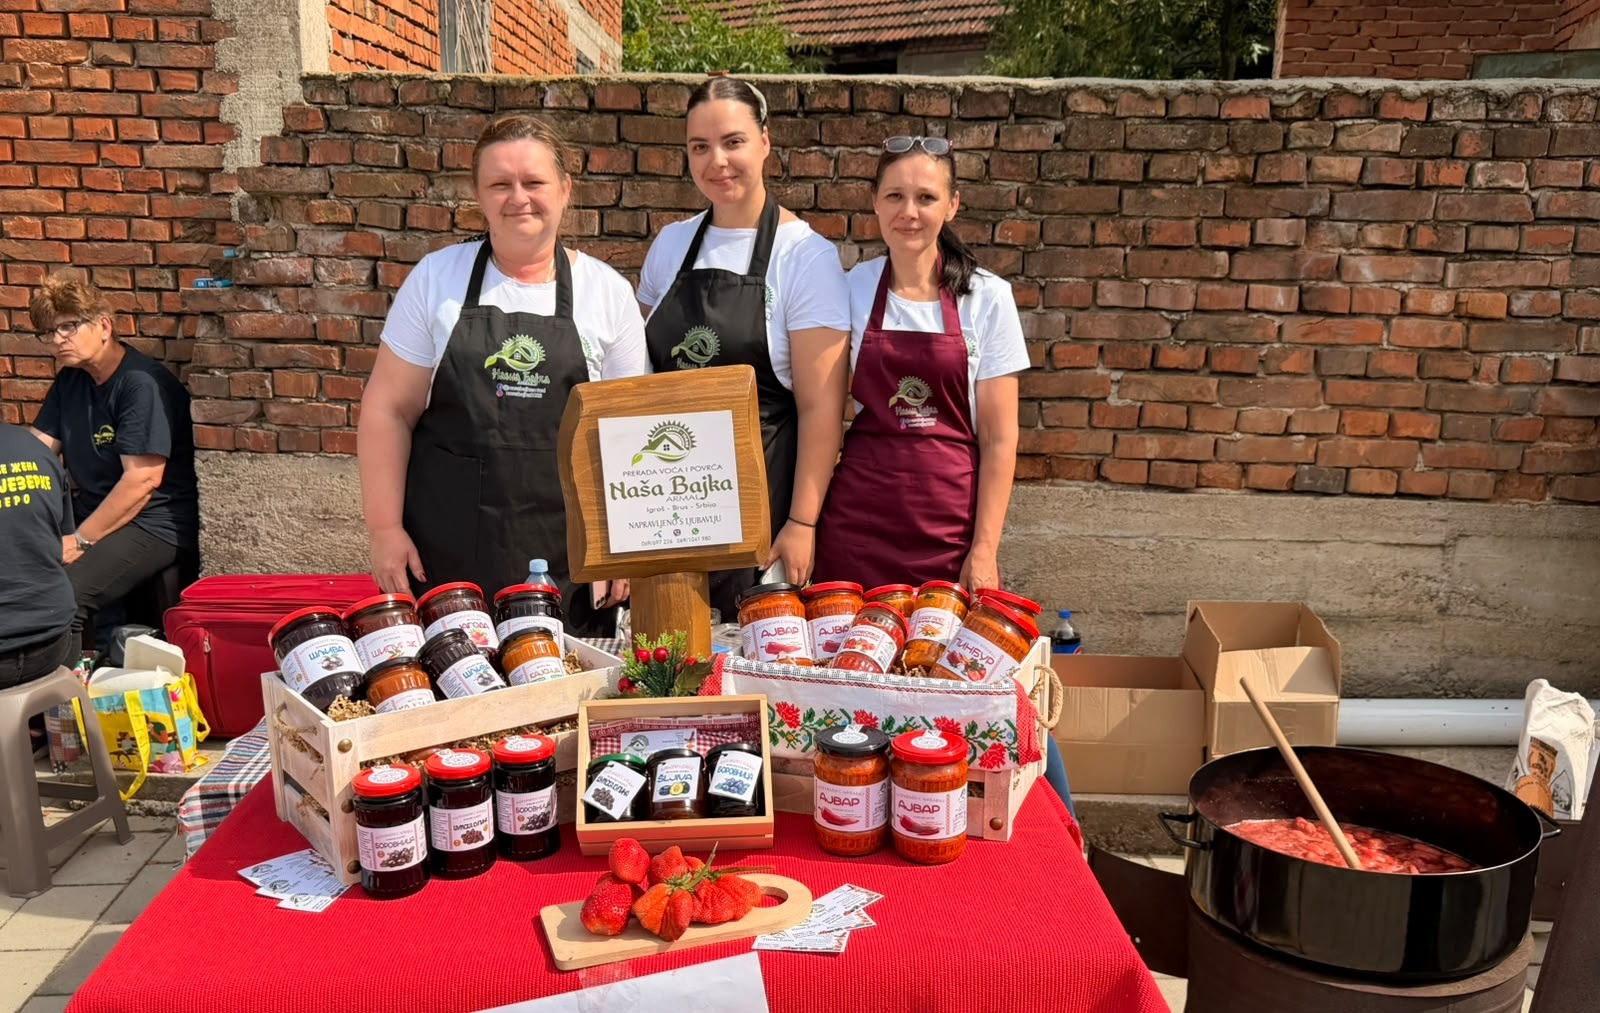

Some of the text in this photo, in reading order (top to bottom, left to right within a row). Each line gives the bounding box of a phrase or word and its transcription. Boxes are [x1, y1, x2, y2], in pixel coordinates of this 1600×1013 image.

[11, 462, 38, 473] ЖЕНА
[623, 469, 657, 477] PRERADA
[609, 473, 733, 501] Naša Bajka
[0, 494, 30, 508] ЕРО
[666, 495, 700, 503] ARMAL
[646, 506, 665, 514] Igroš
[672, 503, 688, 511] Brus
[696, 501, 717, 509] Srbija
[819, 625, 850, 637] АЈВА
[820, 793, 860, 806] АЈВАР
[899, 801, 940, 814] АЈВАР
